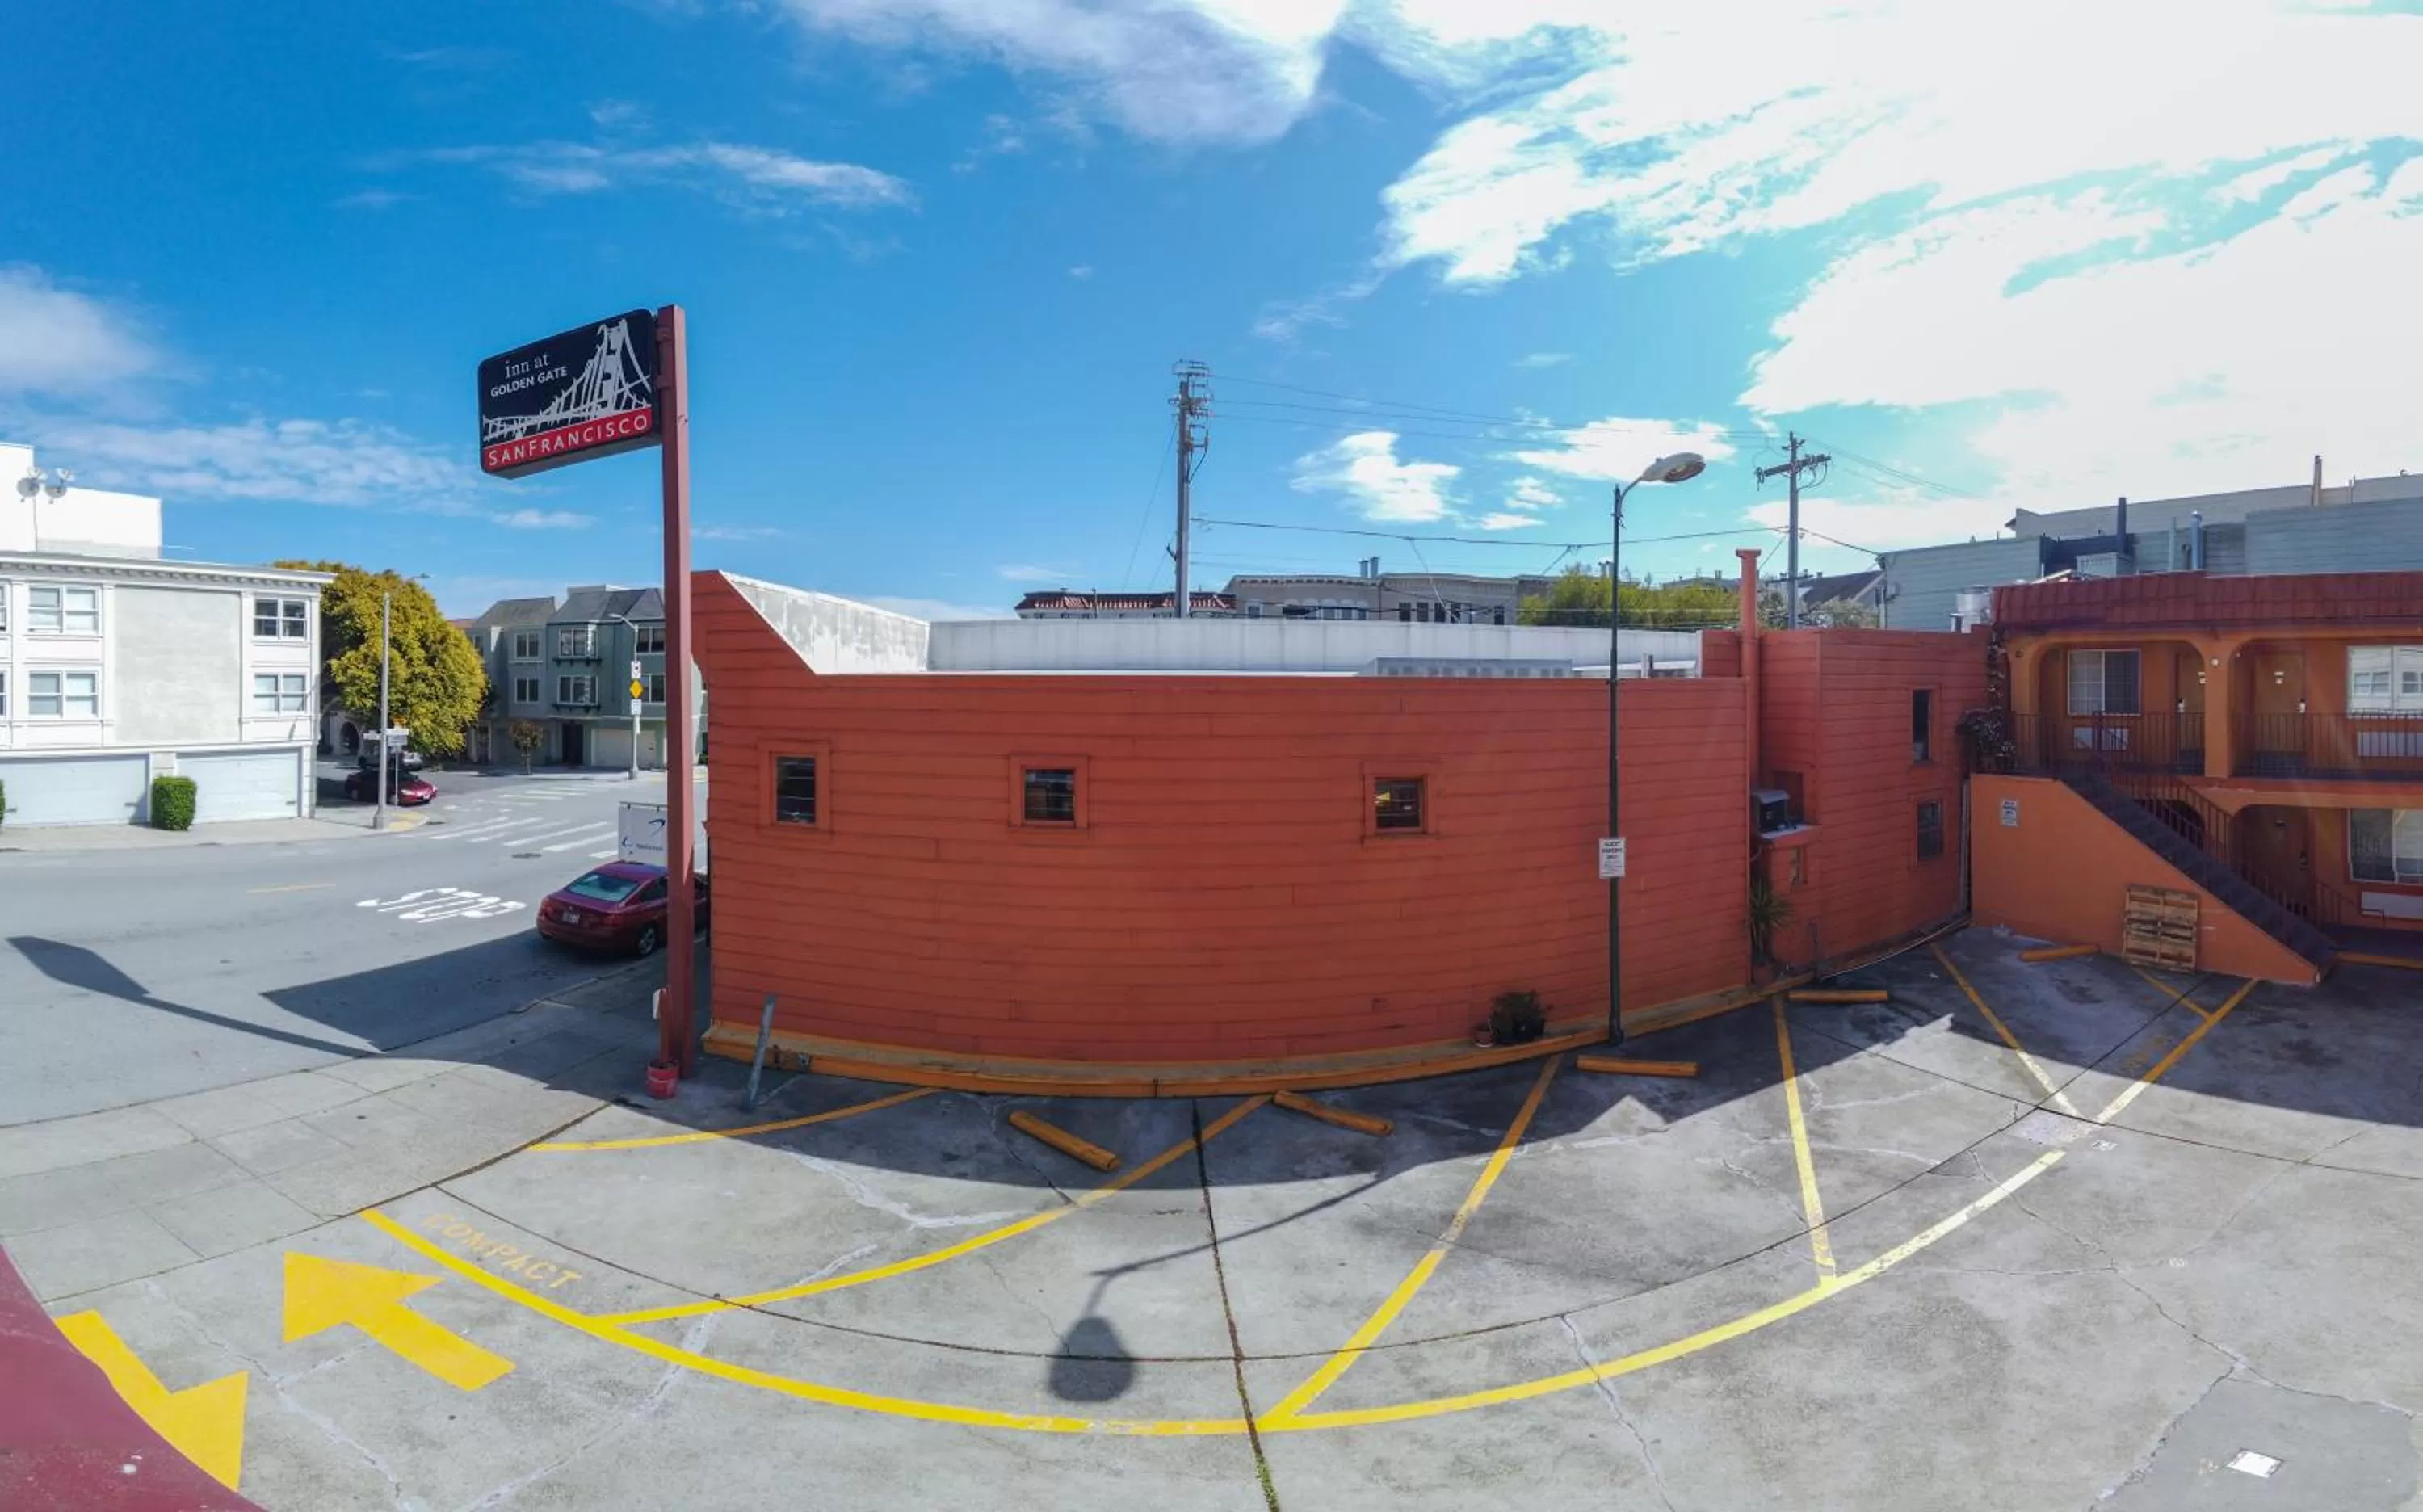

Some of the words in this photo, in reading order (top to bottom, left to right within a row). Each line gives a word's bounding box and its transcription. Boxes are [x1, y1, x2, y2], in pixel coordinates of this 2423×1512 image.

[490, 376, 535, 397] GOLDEN
[537, 366, 569, 384] GATE
[505, 359, 529, 379] inn
[534, 353, 549, 369] at
[422, 1214, 582, 1289] COMPACT
